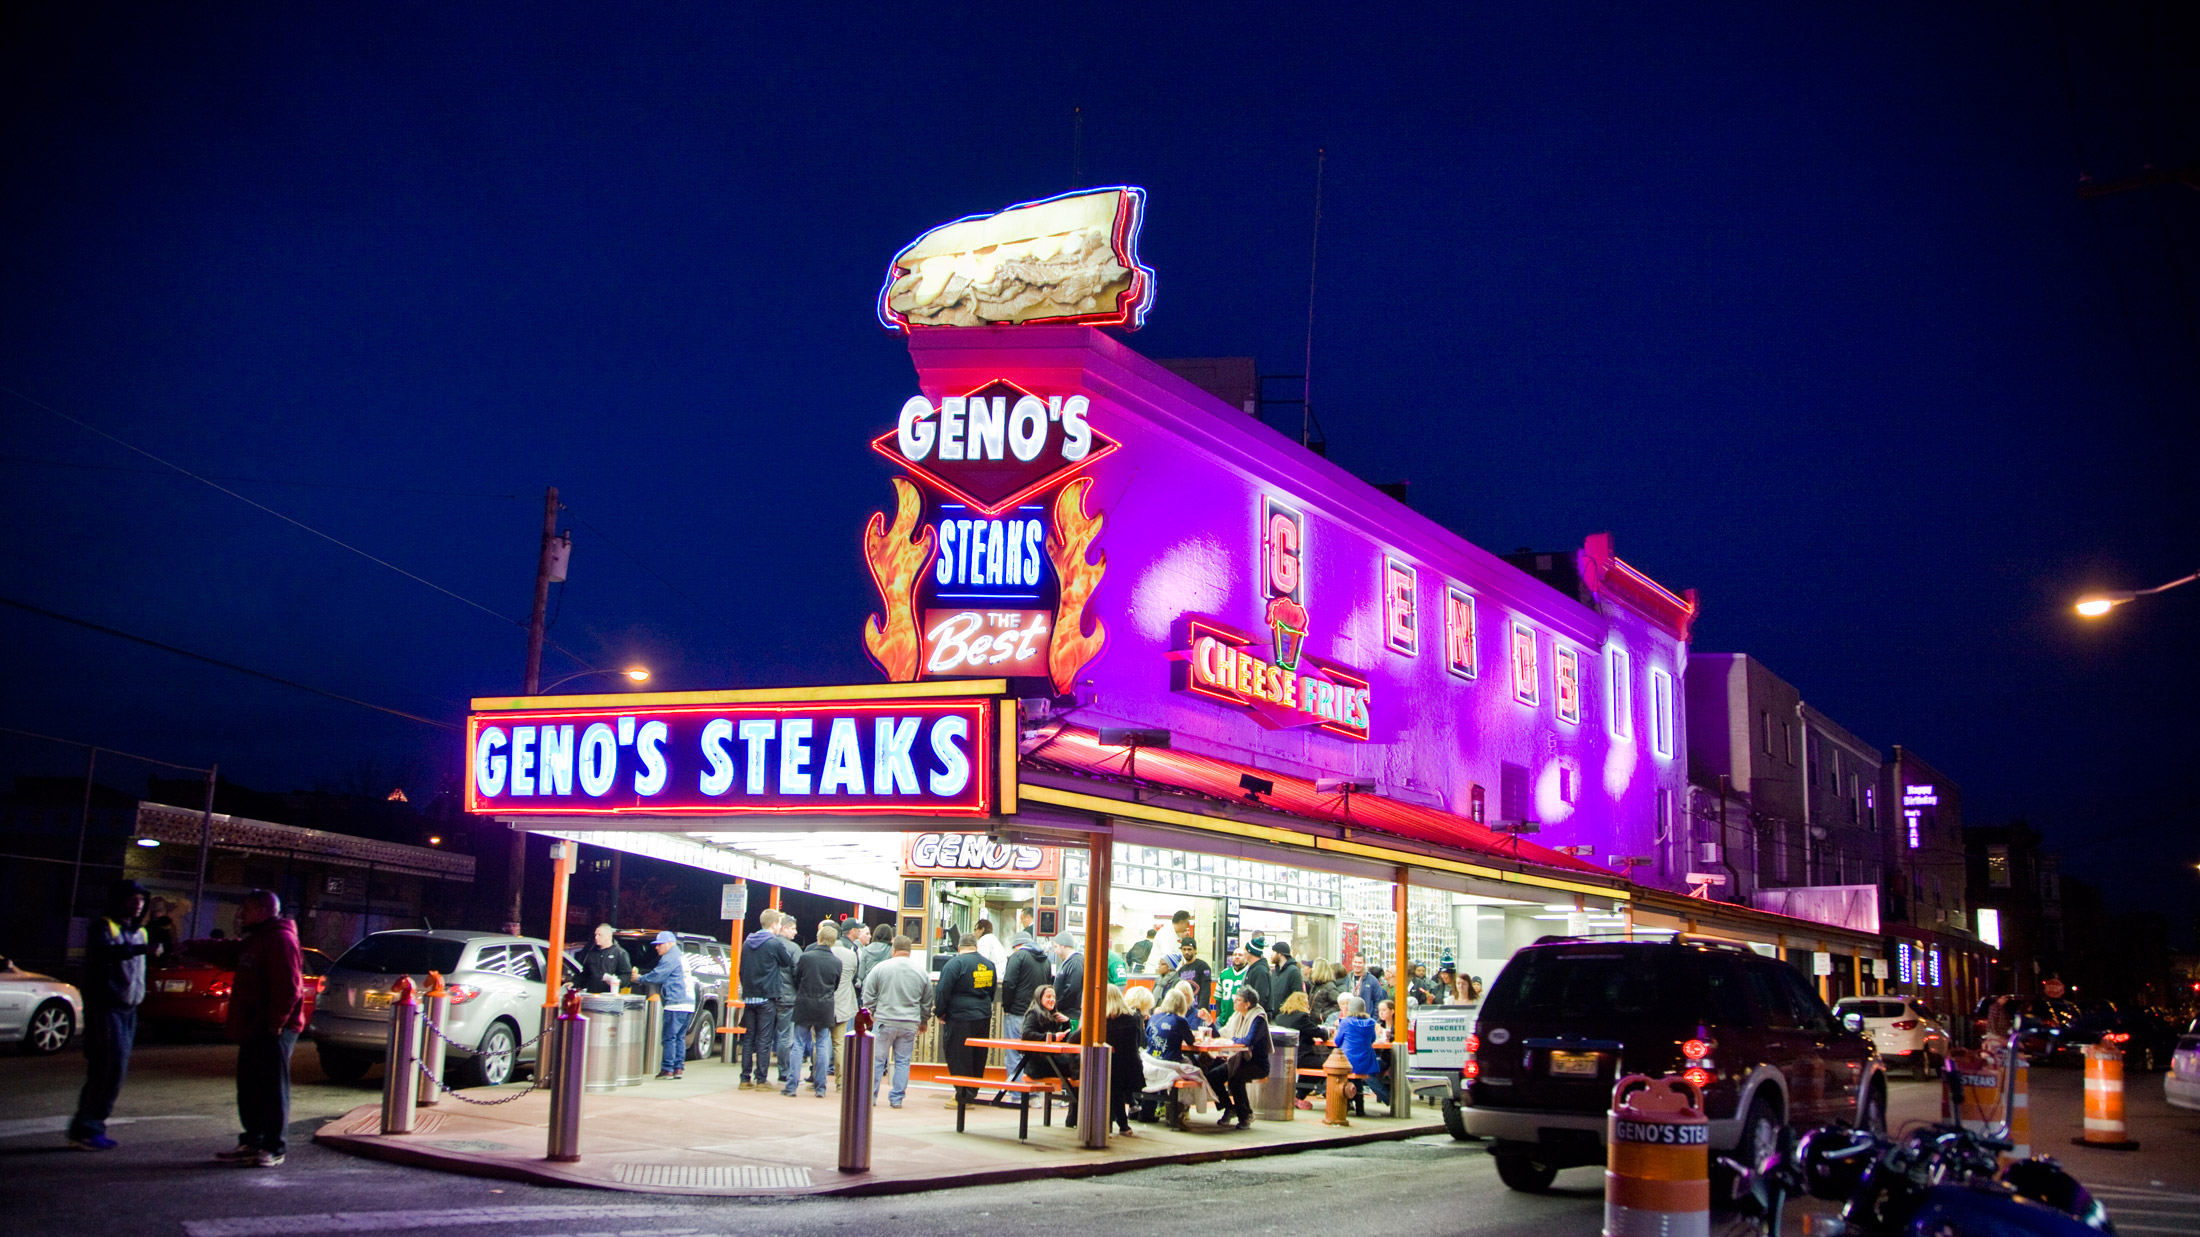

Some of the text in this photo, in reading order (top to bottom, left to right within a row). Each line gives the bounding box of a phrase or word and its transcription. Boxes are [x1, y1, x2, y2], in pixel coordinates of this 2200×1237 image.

[897, 395, 1092, 462] GENO'S
[936, 518, 1043, 586] STEAKS
[927, 611, 1048, 673] Best
[987, 612, 1022, 628] THE
[1194, 636, 1370, 730] CHEESE FRIES
[476, 715, 971, 797] GENO'S STEAKS
[911, 833, 1044, 871] GENO'S
[1616, 1121, 1676, 1142] GENO'S
